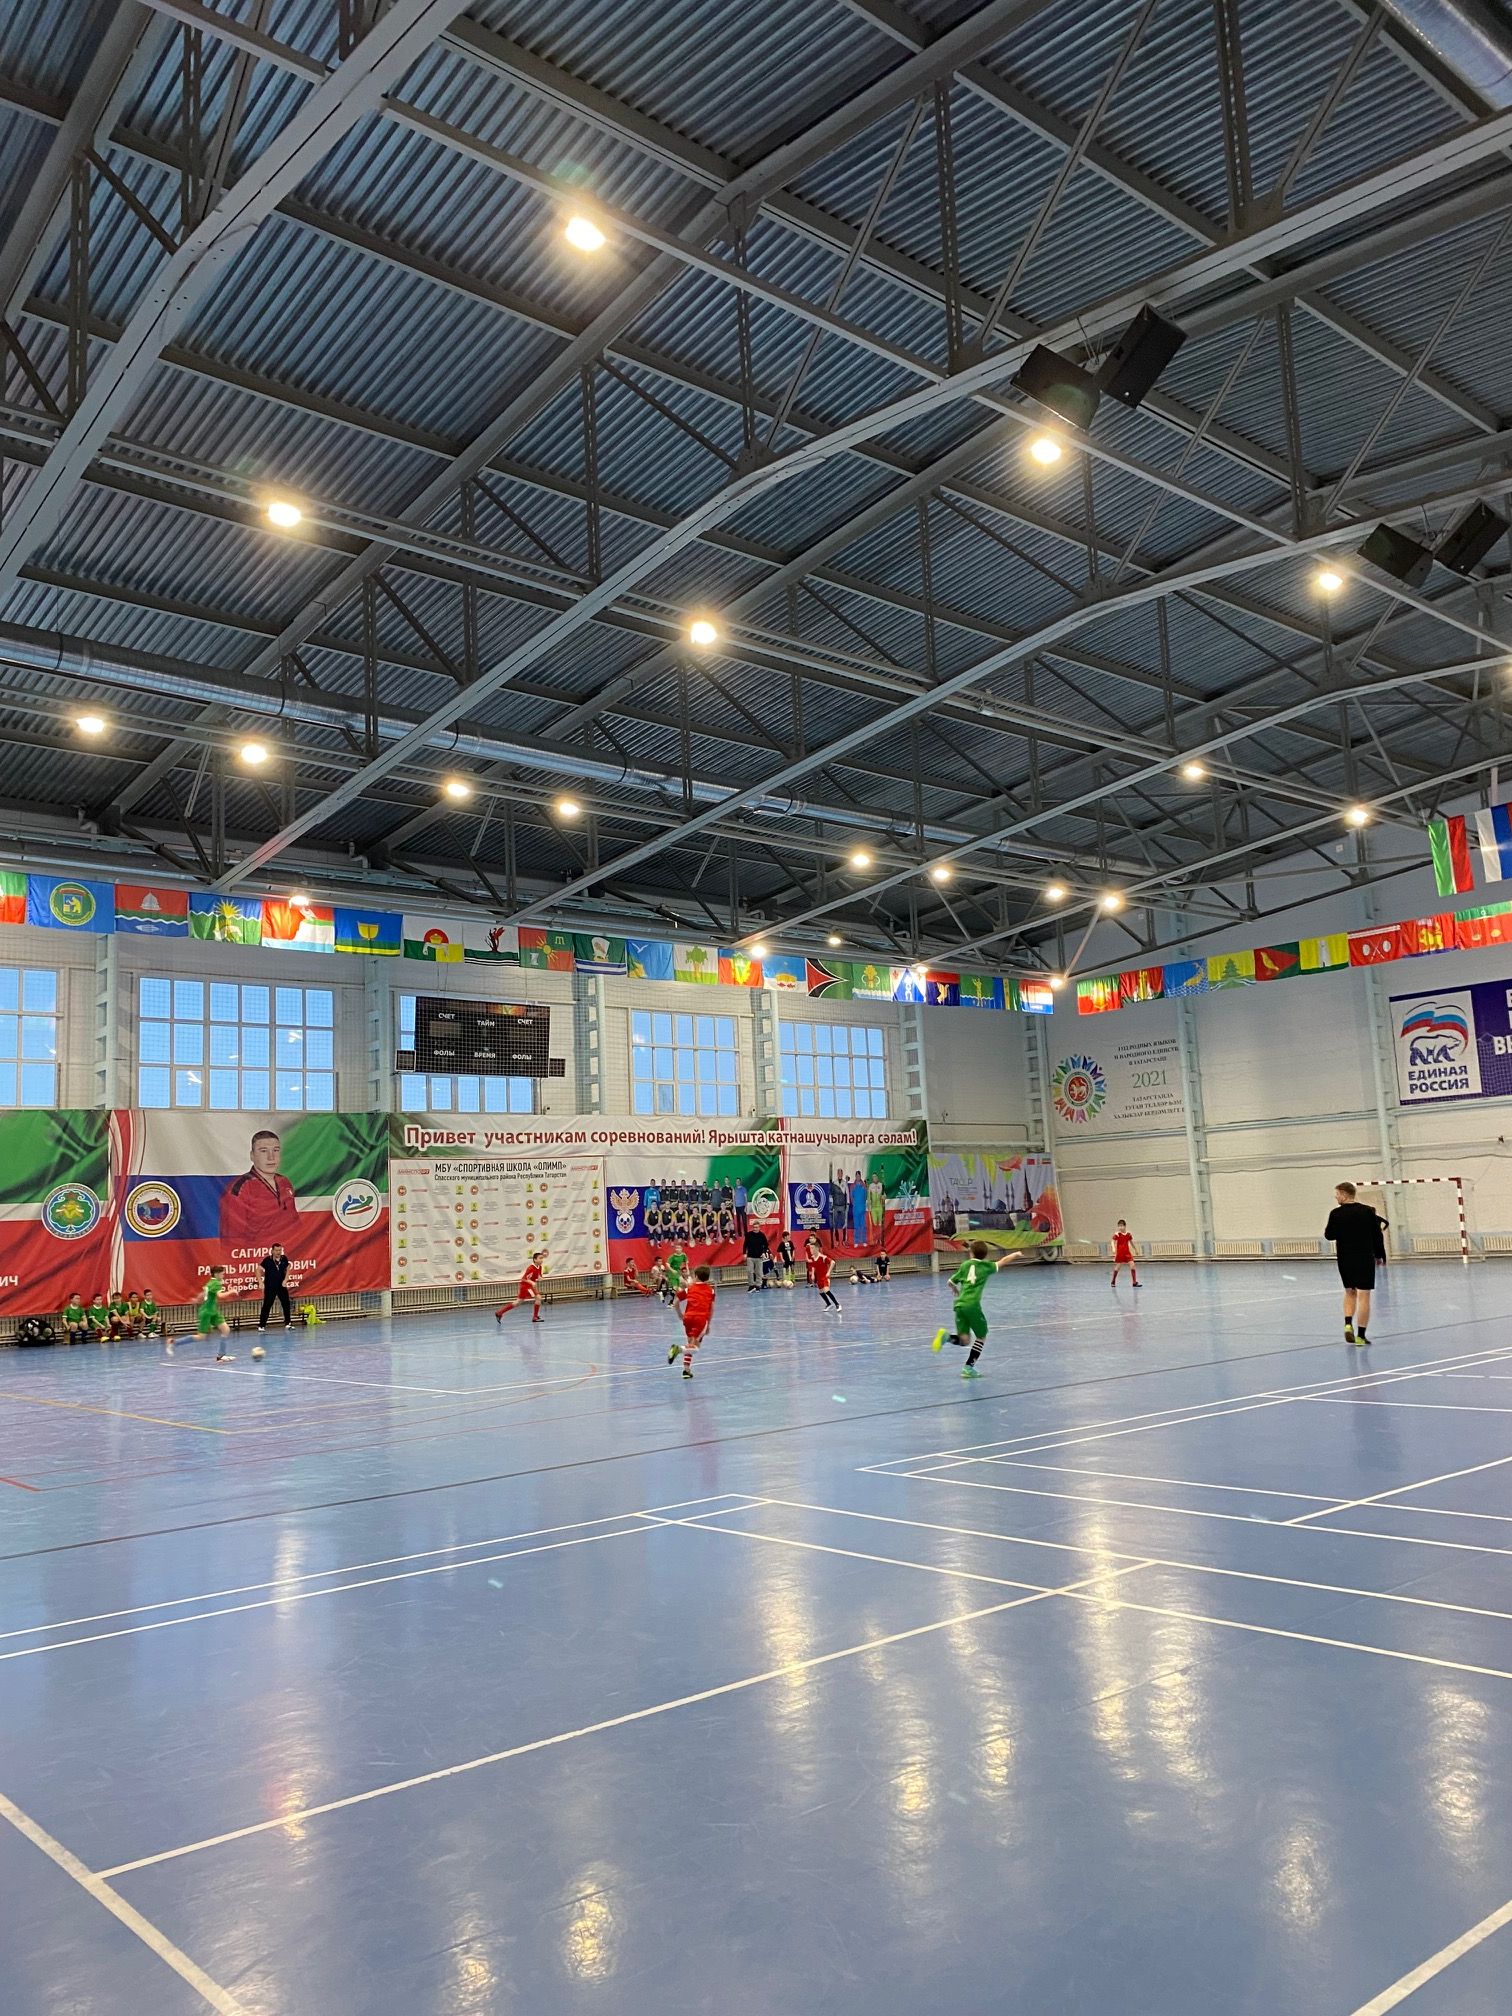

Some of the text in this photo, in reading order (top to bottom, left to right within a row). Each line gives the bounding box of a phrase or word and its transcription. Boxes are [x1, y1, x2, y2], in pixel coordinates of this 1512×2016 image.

[438, 1012, 456, 1020] СЧЕТ
[477, 1019, 495, 1027] ТАЙМ
[434, 1049, 455, 1057] ФОЛЫ
[1152, 1046, 1179, 1055] ЕДИНСТВ
[1408, 1065, 1468, 1081] ЕДИНАЯ
[1131, 1069, 1167, 1089] 2021
[1409, 1078, 1469, 1094] РОССИЯ
[406, 1127, 916, 1149] Привет участникам соревнований! Ярышта катнашучыларга сәлам!
[435, 1161, 567, 1173] МБУ «СПОРТИВНАЯ ШКОЛА «ОЛИМП»
[461, 1174, 499, 1182] муниципального
[499, 1173, 516, 1181] района
[517, 1172, 544, 1180] Республики
